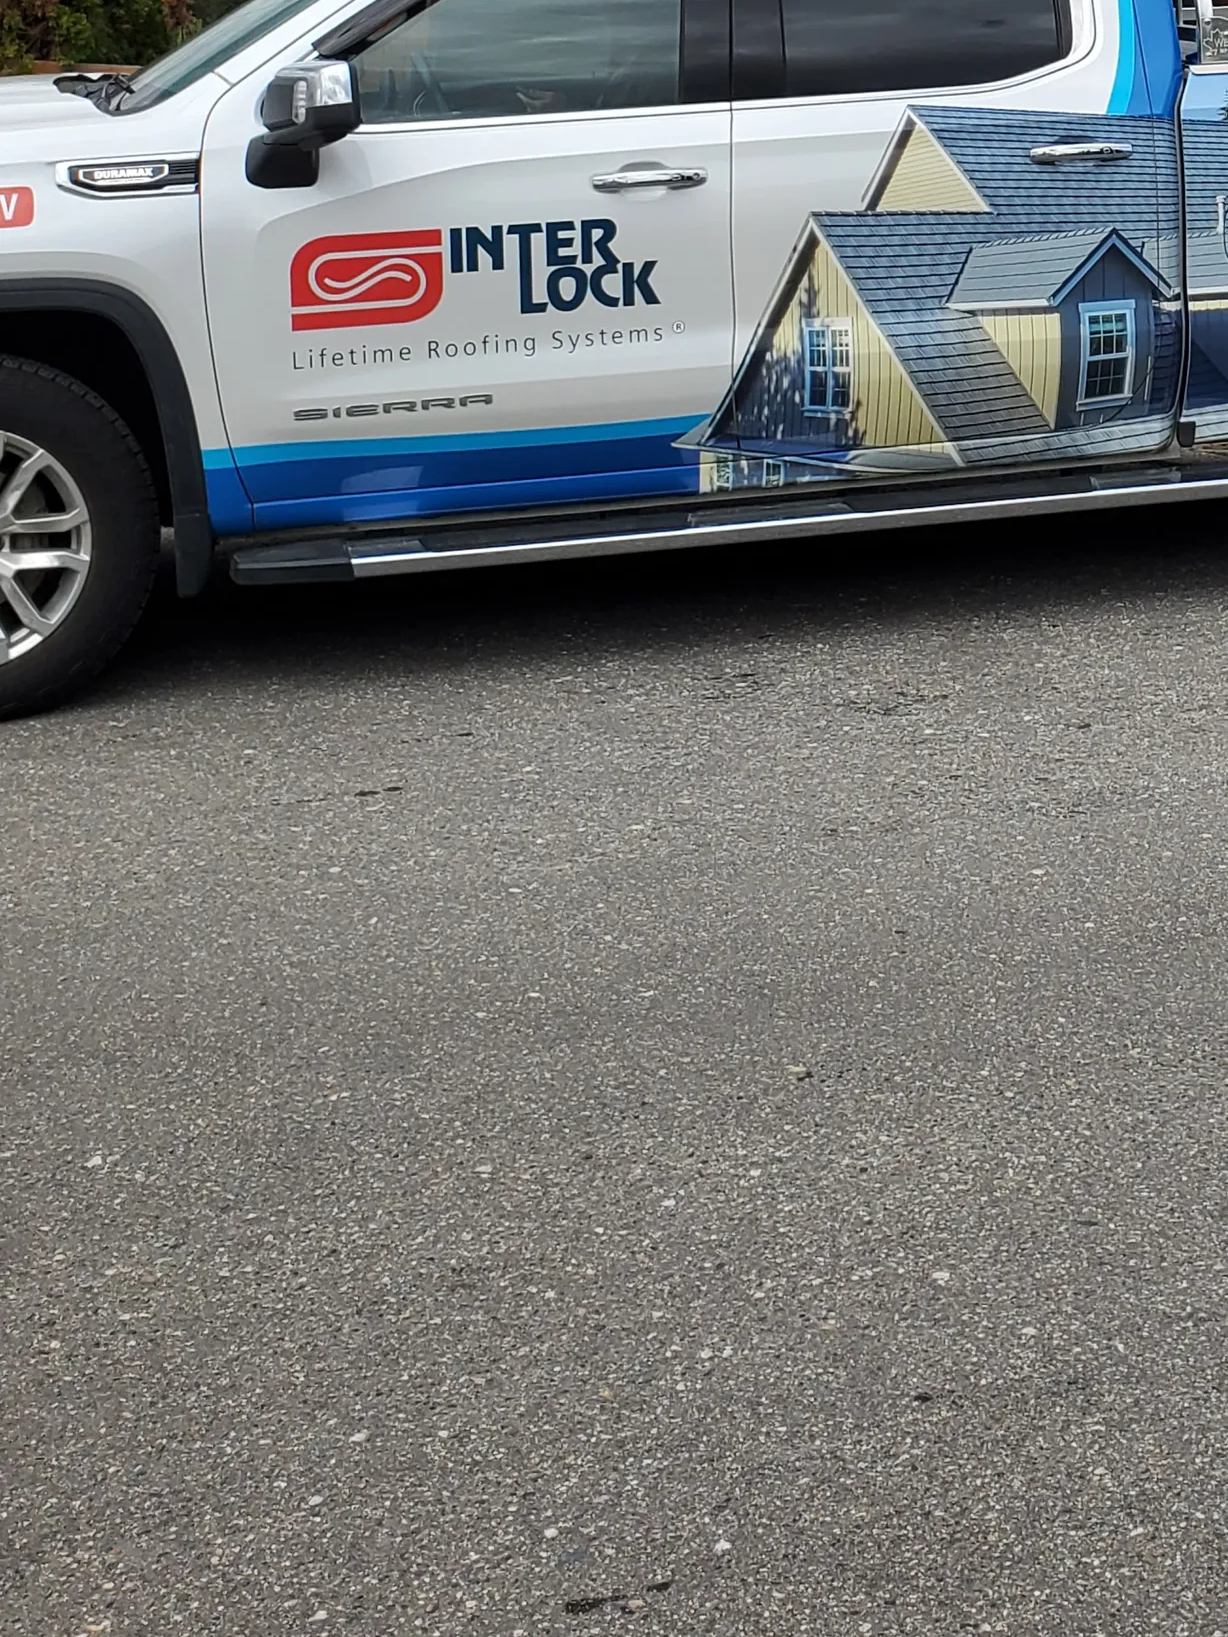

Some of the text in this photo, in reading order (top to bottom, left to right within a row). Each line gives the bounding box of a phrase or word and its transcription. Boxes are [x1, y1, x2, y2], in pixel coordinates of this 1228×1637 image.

[94, 168, 153, 180] DURAMAX
[450, 218, 621, 273] INTER
[519, 260, 662, 314] LOCK
[292, 345, 412, 370] Lifetime
[428, 331, 537, 360] Roofing
[293, 393, 494, 421] SIERRA
